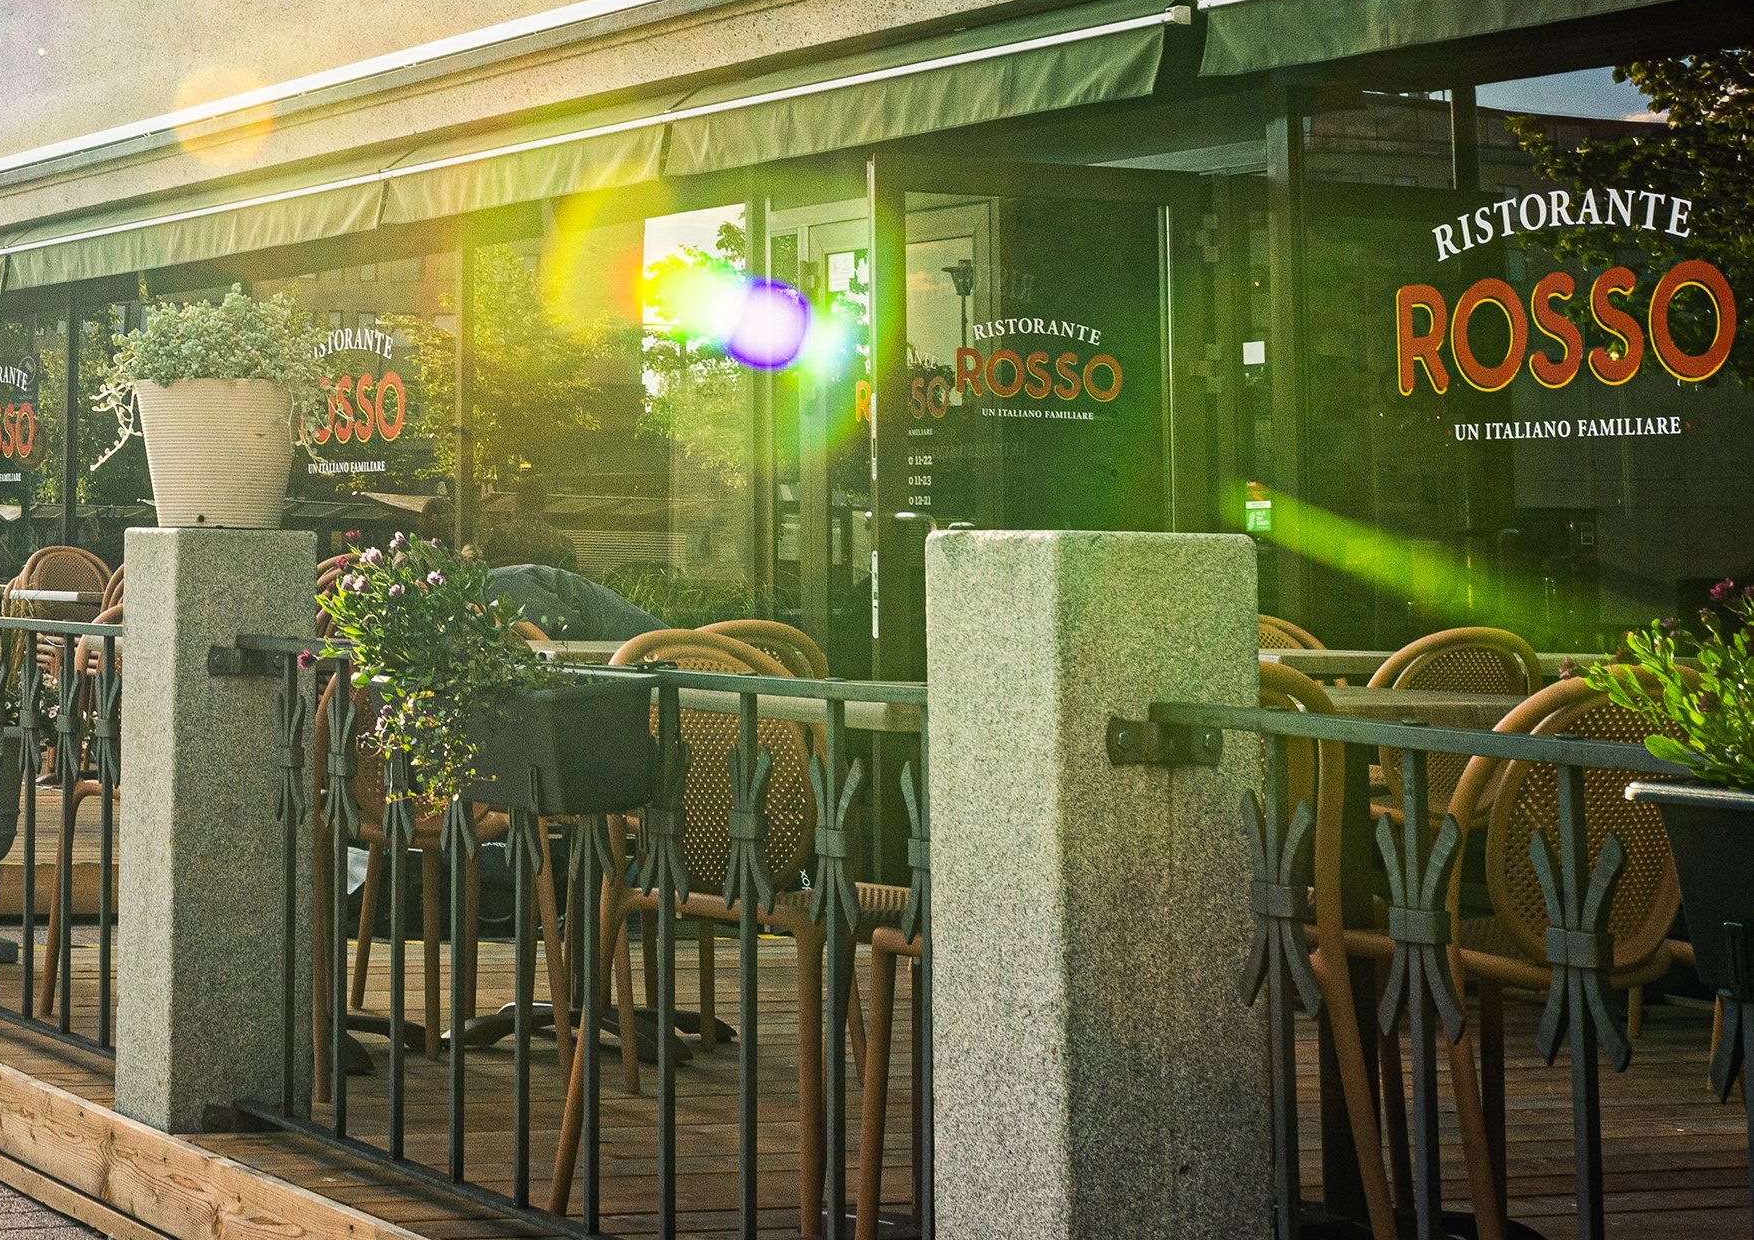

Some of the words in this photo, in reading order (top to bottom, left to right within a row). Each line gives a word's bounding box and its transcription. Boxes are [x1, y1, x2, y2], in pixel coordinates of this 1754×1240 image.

[1431, 187, 1693, 263] RISTORANTE
[972, 317, 1102, 347] RISTORANTE
[1396, 259, 1737, 396] ROSSO
[954, 346, 1123, 402] ROSSO
[982, 408, 995, 417] UN
[998, 408, 1043, 418] ITALIANO
[1045, 410, 1095, 421] FAMILIARE
[1454, 422, 1480, 441] UN
[1485, 419, 1572, 441] ITALIANO
[1577, 416, 1683, 438] FAMILIARE
[350, 460, 386, 473] FAMILIARE
